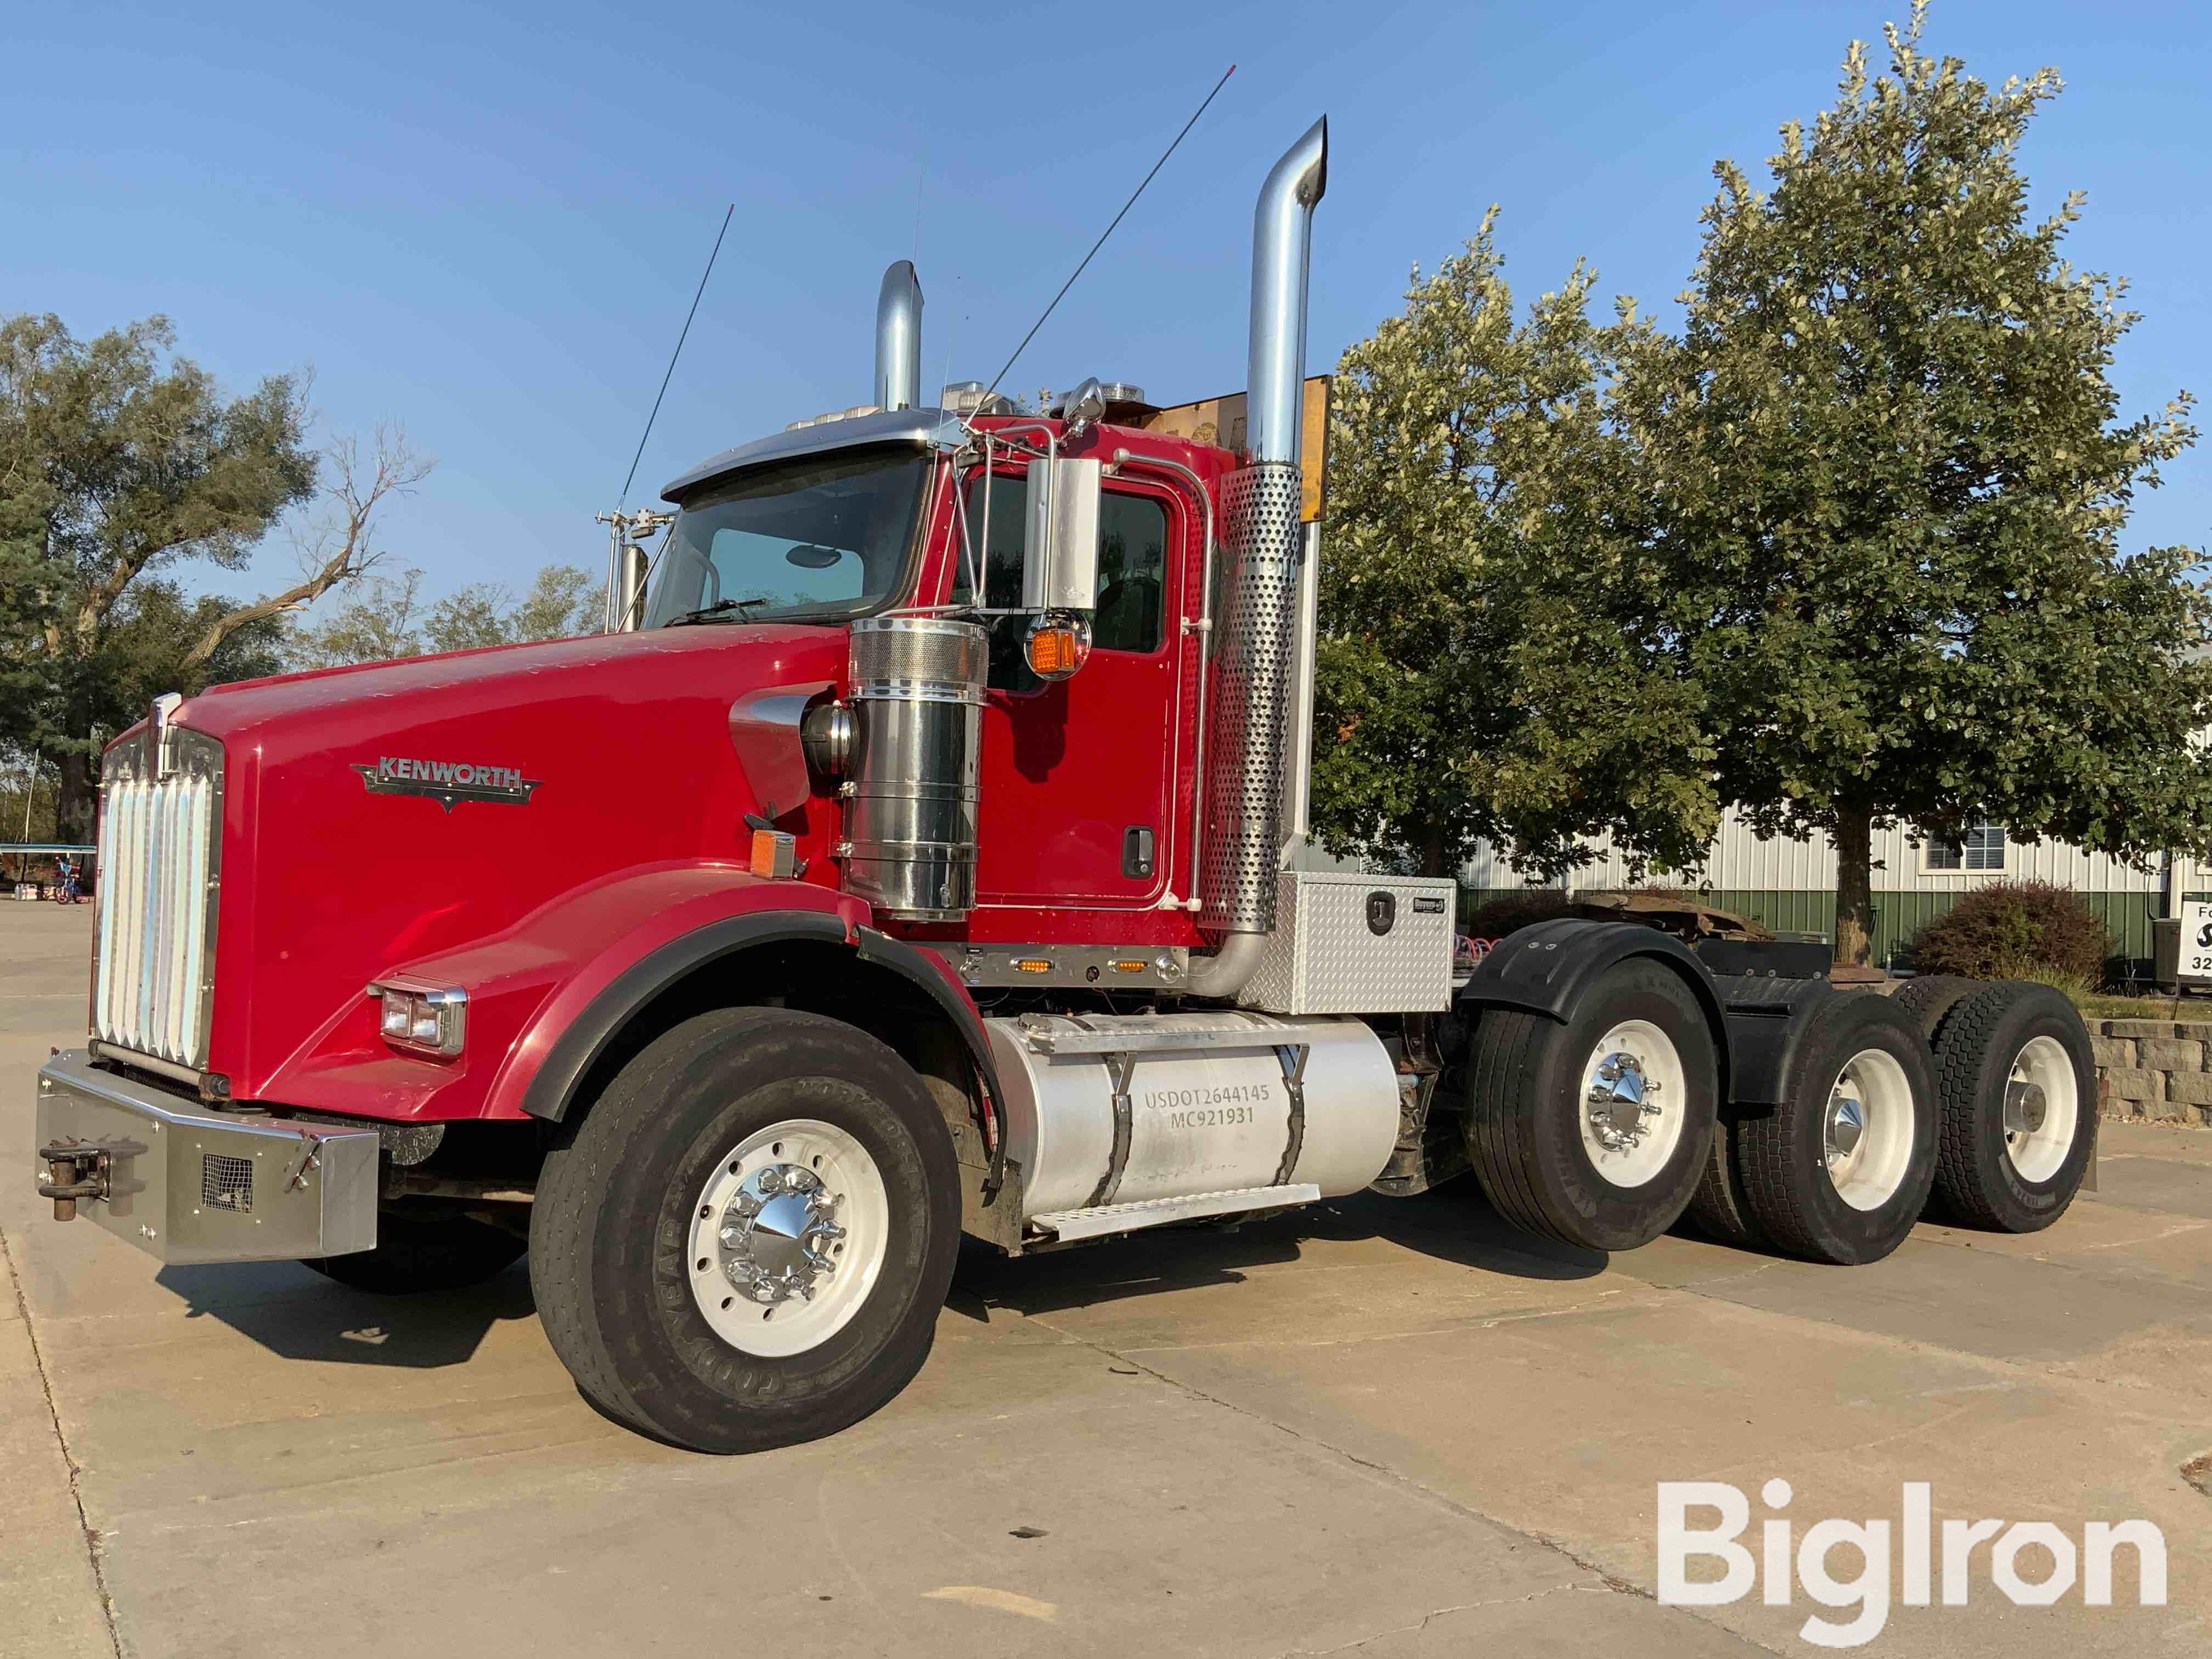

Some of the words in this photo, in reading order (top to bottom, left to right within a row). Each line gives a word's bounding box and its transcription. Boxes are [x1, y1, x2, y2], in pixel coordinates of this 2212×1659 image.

[379, 756, 521, 789] KENWORTH
[1145, 1084, 1269, 1109] USDOT2644145
[1171, 1106, 1253, 1128] MC921931
